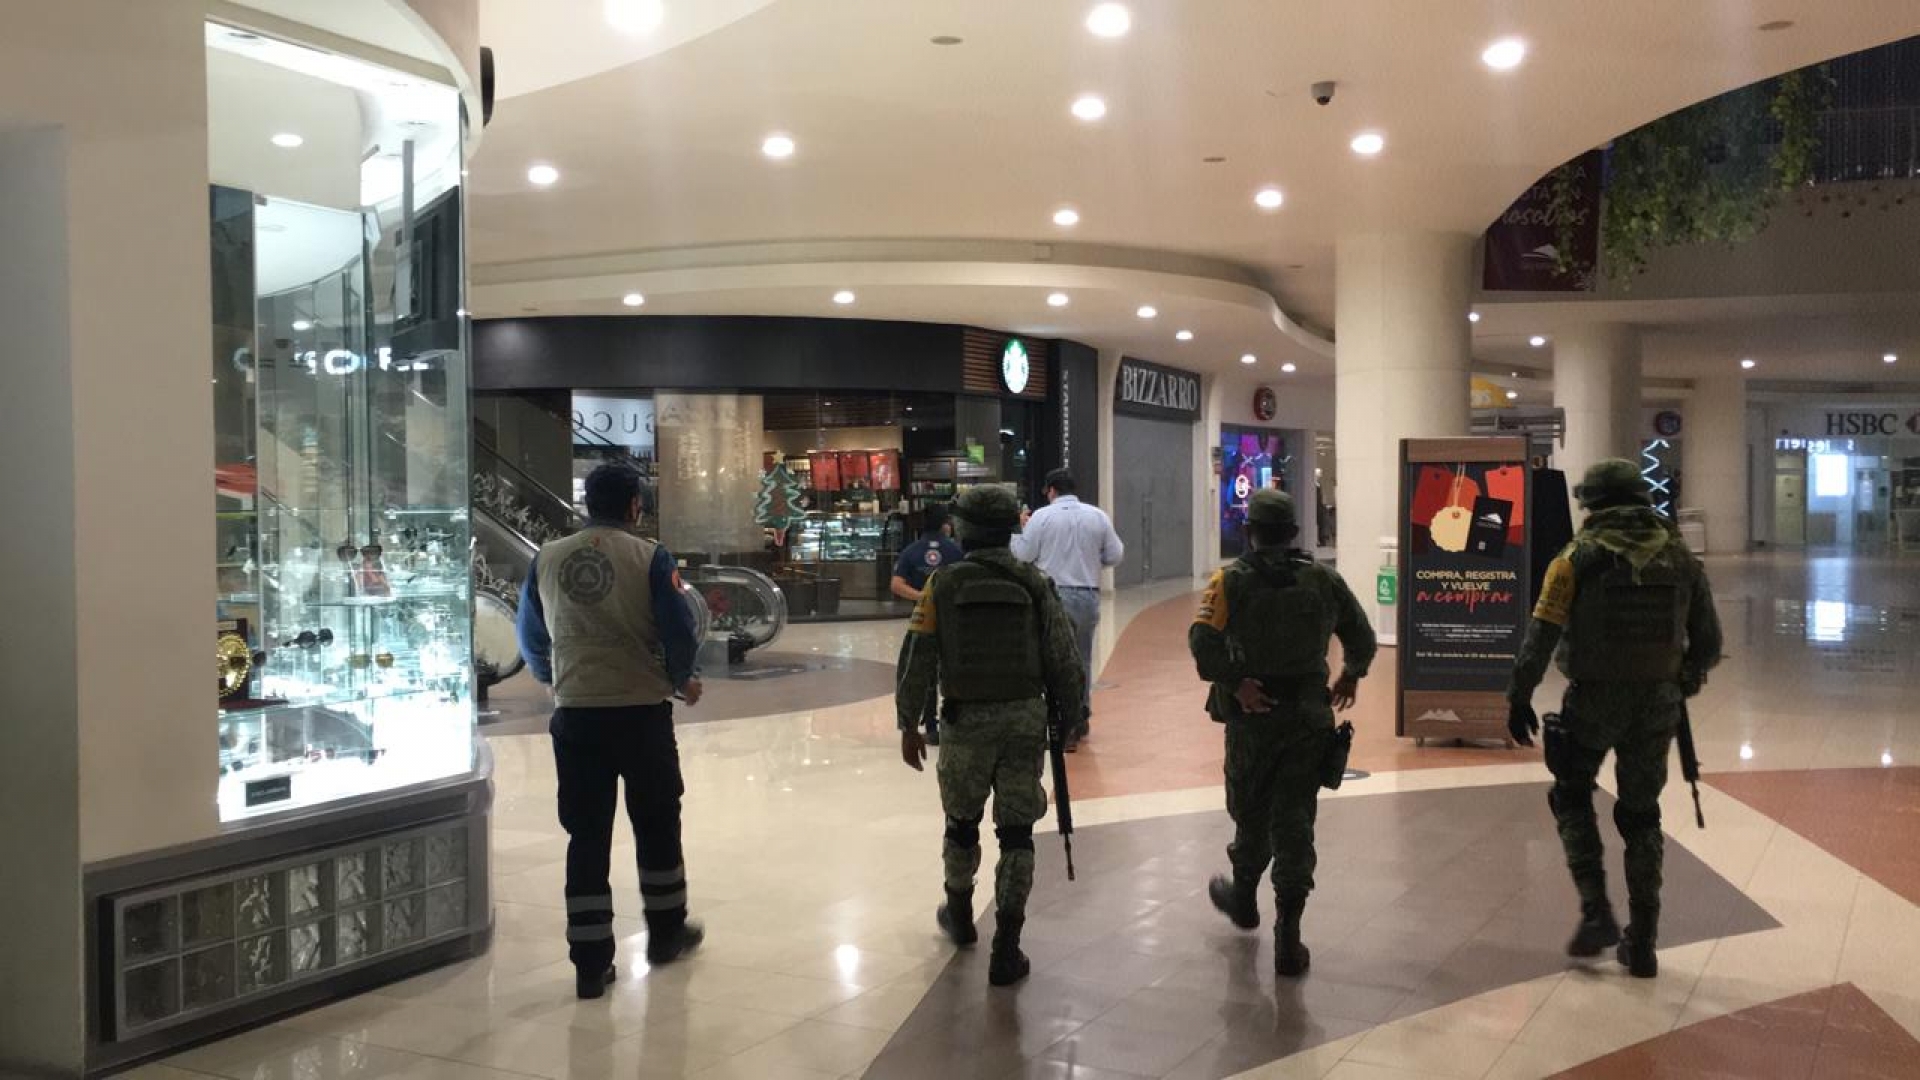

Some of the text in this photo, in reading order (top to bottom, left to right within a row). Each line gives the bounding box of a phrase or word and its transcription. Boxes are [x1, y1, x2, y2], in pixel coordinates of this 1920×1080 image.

[1123, 365, 1197, 411] BIZZARRO
[1826, 413, 1898, 436] HSBC
[1416, 570, 1516, 580] COMPRA, REGISTRA
[1441, 581, 1491, 590] Y VUELVE
